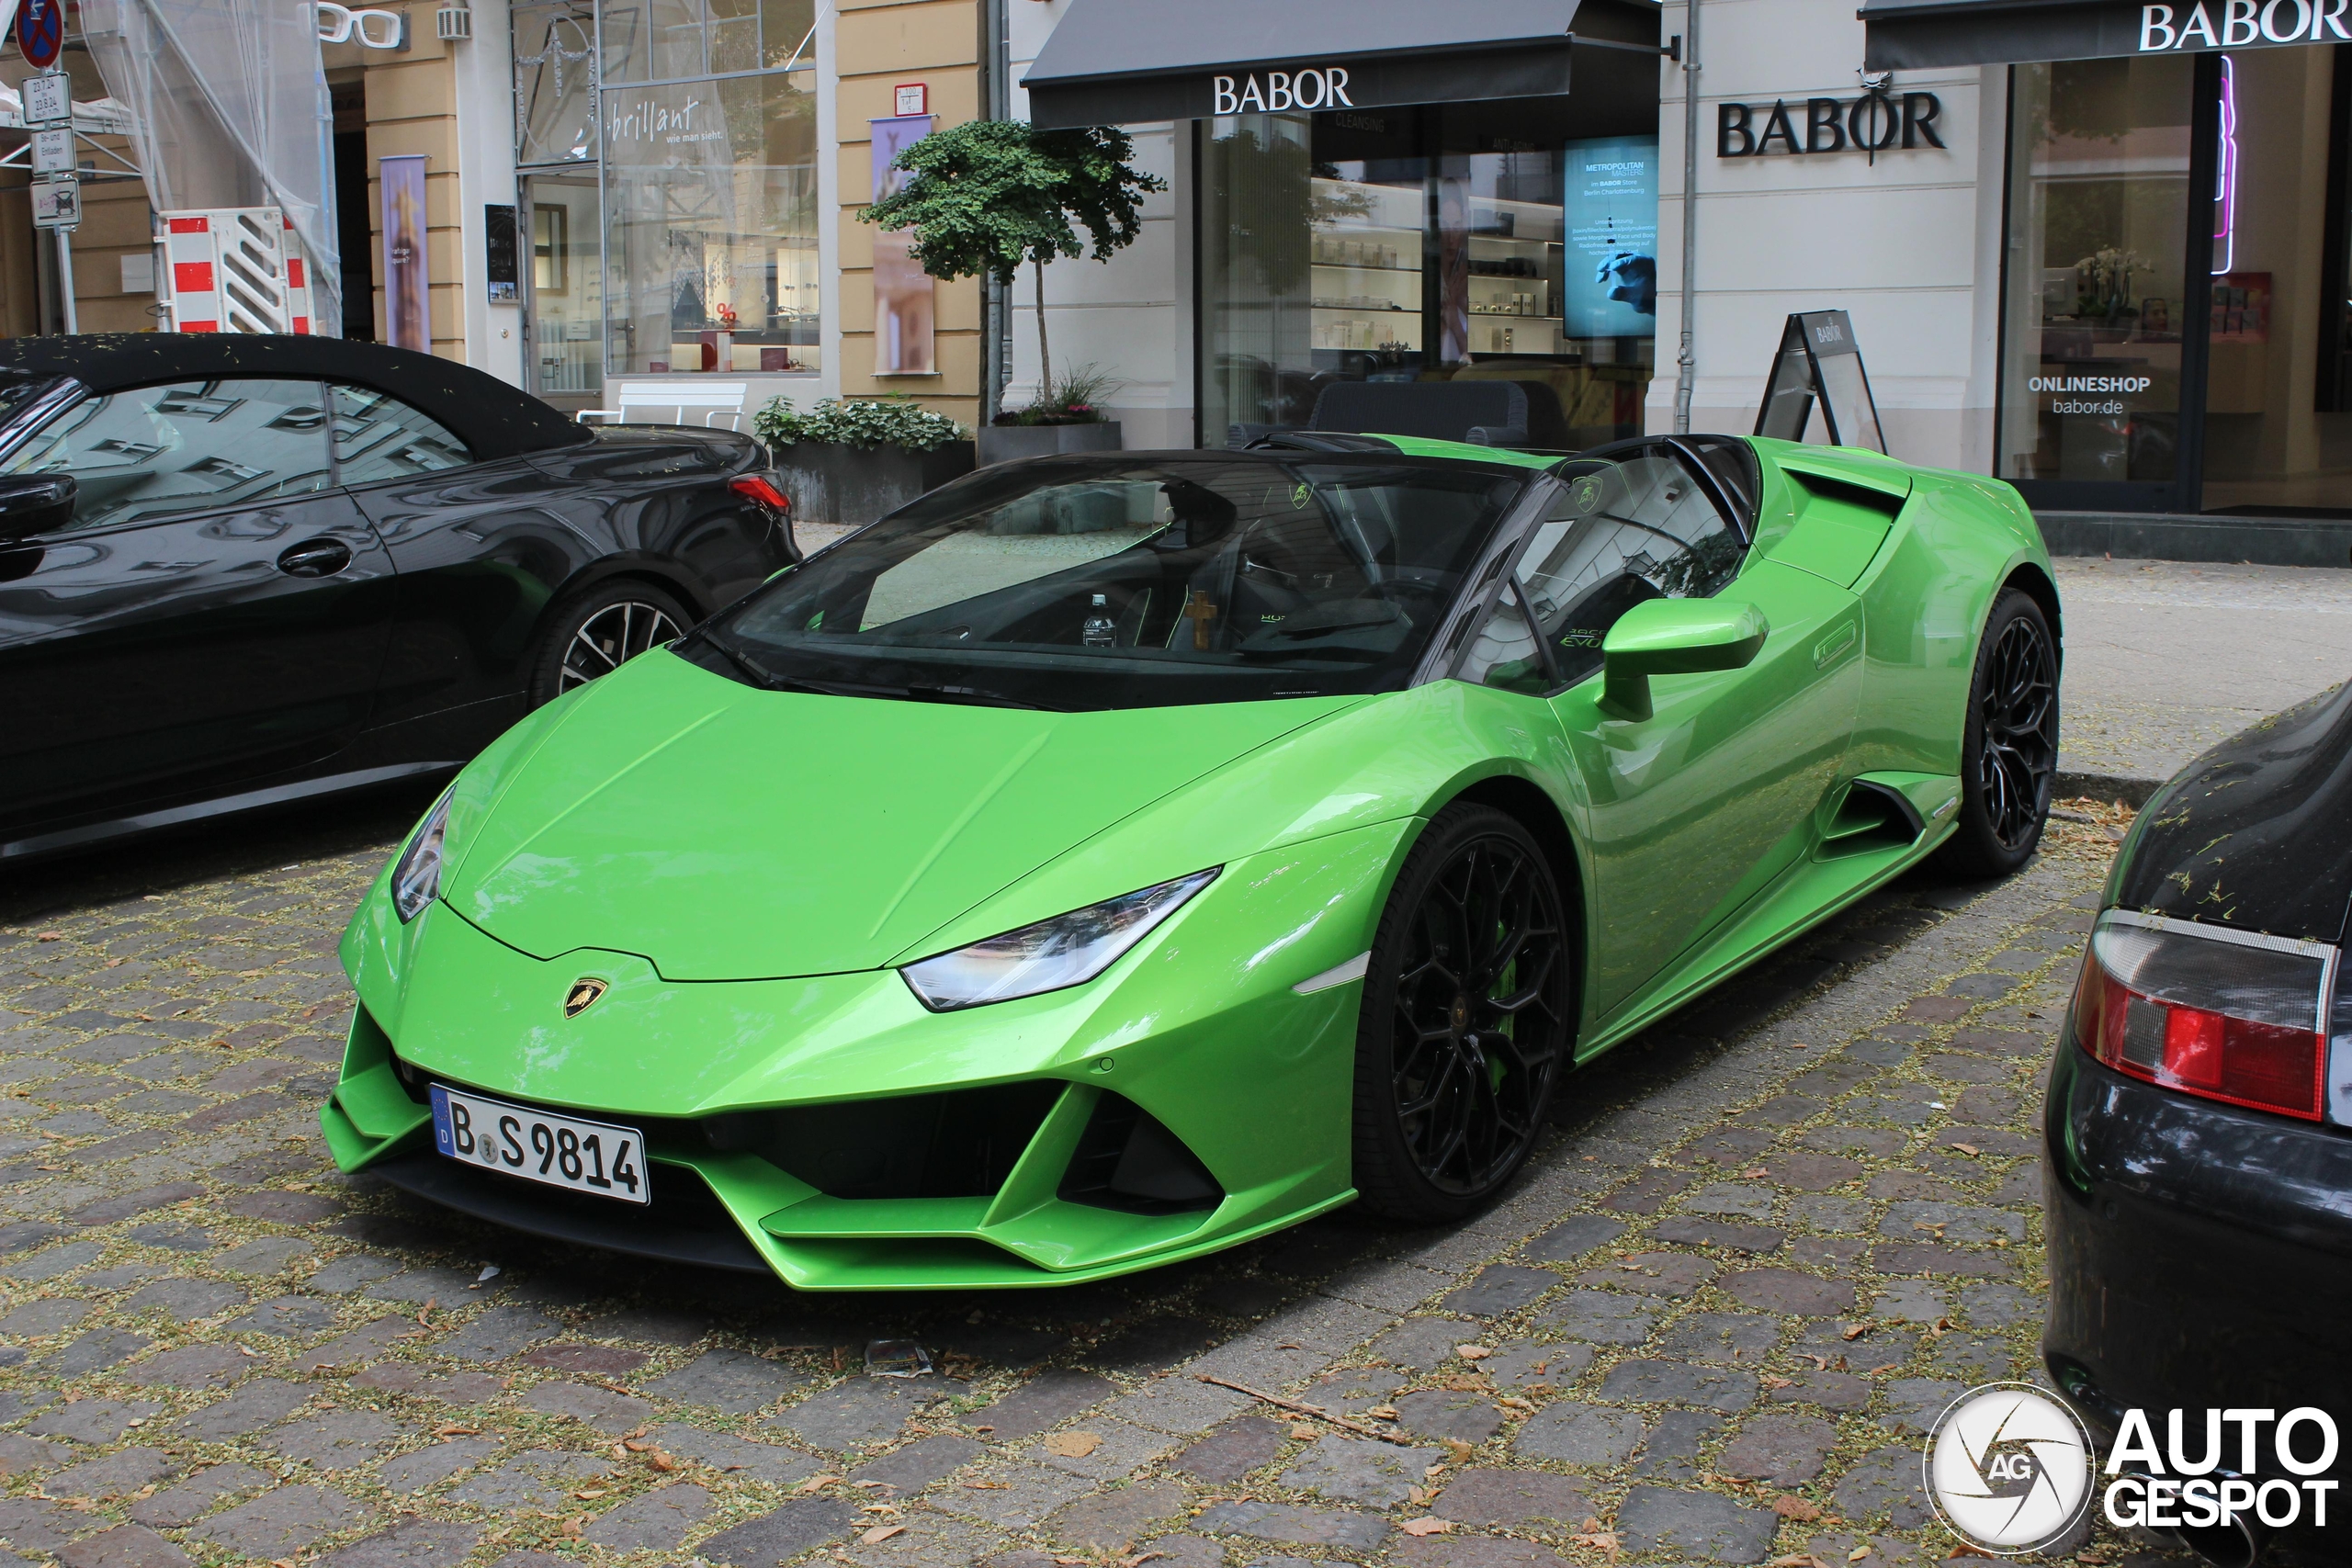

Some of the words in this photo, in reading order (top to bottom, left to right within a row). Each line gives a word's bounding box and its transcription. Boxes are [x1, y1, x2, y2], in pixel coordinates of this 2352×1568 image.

[2139, 0, 2352, 51] BABOR
[33, 78, 55, 93] 23.7.24
[1214, 67, 1354, 115] BABOR
[35, 96, 57, 111] 23.8.24
[612, 96, 699, 141] brillant
[1335, 112, 1385, 133] CLEANSING
[1717, 92, 1948, 158] BABOR
[666, 134, 681, 143] wie
[683, 133, 699, 142] man
[701, 130, 723, 141] sieht.
[1492, 137, 1535, 155] ANTI-AGING
[1586, 162, 1644, 172] METROPOLITAN
[1815, 324, 1844, 344] BABOR
[2028, 377, 2151, 392] ONLINESHOP
[2052, 399, 2124, 414] babor.de
[1559, 637, 1602, 649] EVO
[440, 1129, 448, 1144] D
[450, 1100, 476, 1155] B
